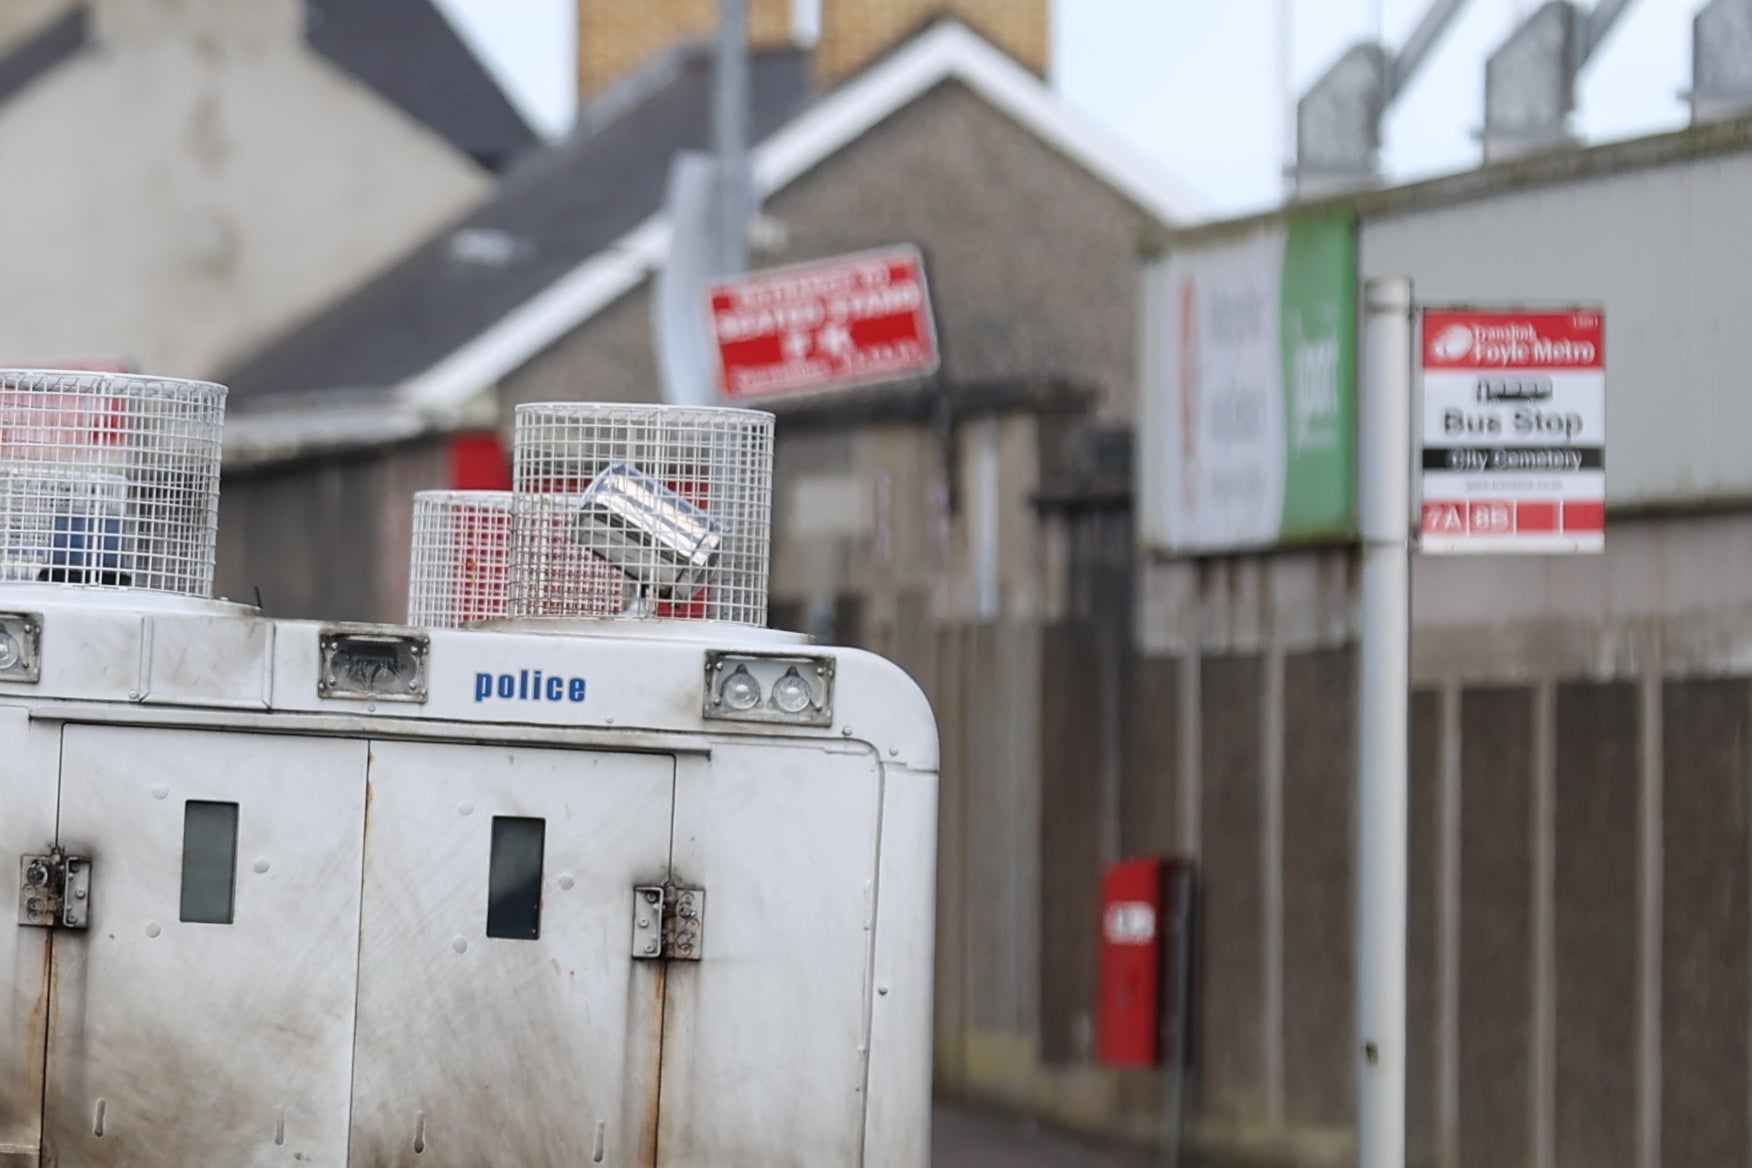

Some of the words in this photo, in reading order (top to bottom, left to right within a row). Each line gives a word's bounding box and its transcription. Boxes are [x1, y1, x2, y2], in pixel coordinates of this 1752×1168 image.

[1474, 323, 1538, 342] Translink
[1475, 338, 1530, 366] Foyle
[1534, 338, 1595, 364] Metro
[1443, 408, 1502, 435] Bus
[1512, 407, 1583, 442] Stop
[1451, 449, 1488, 471] City
[1494, 449, 1583, 472] Cemetery
[1427, 505, 1462, 529] 7A
[474, 669, 586, 702] police
